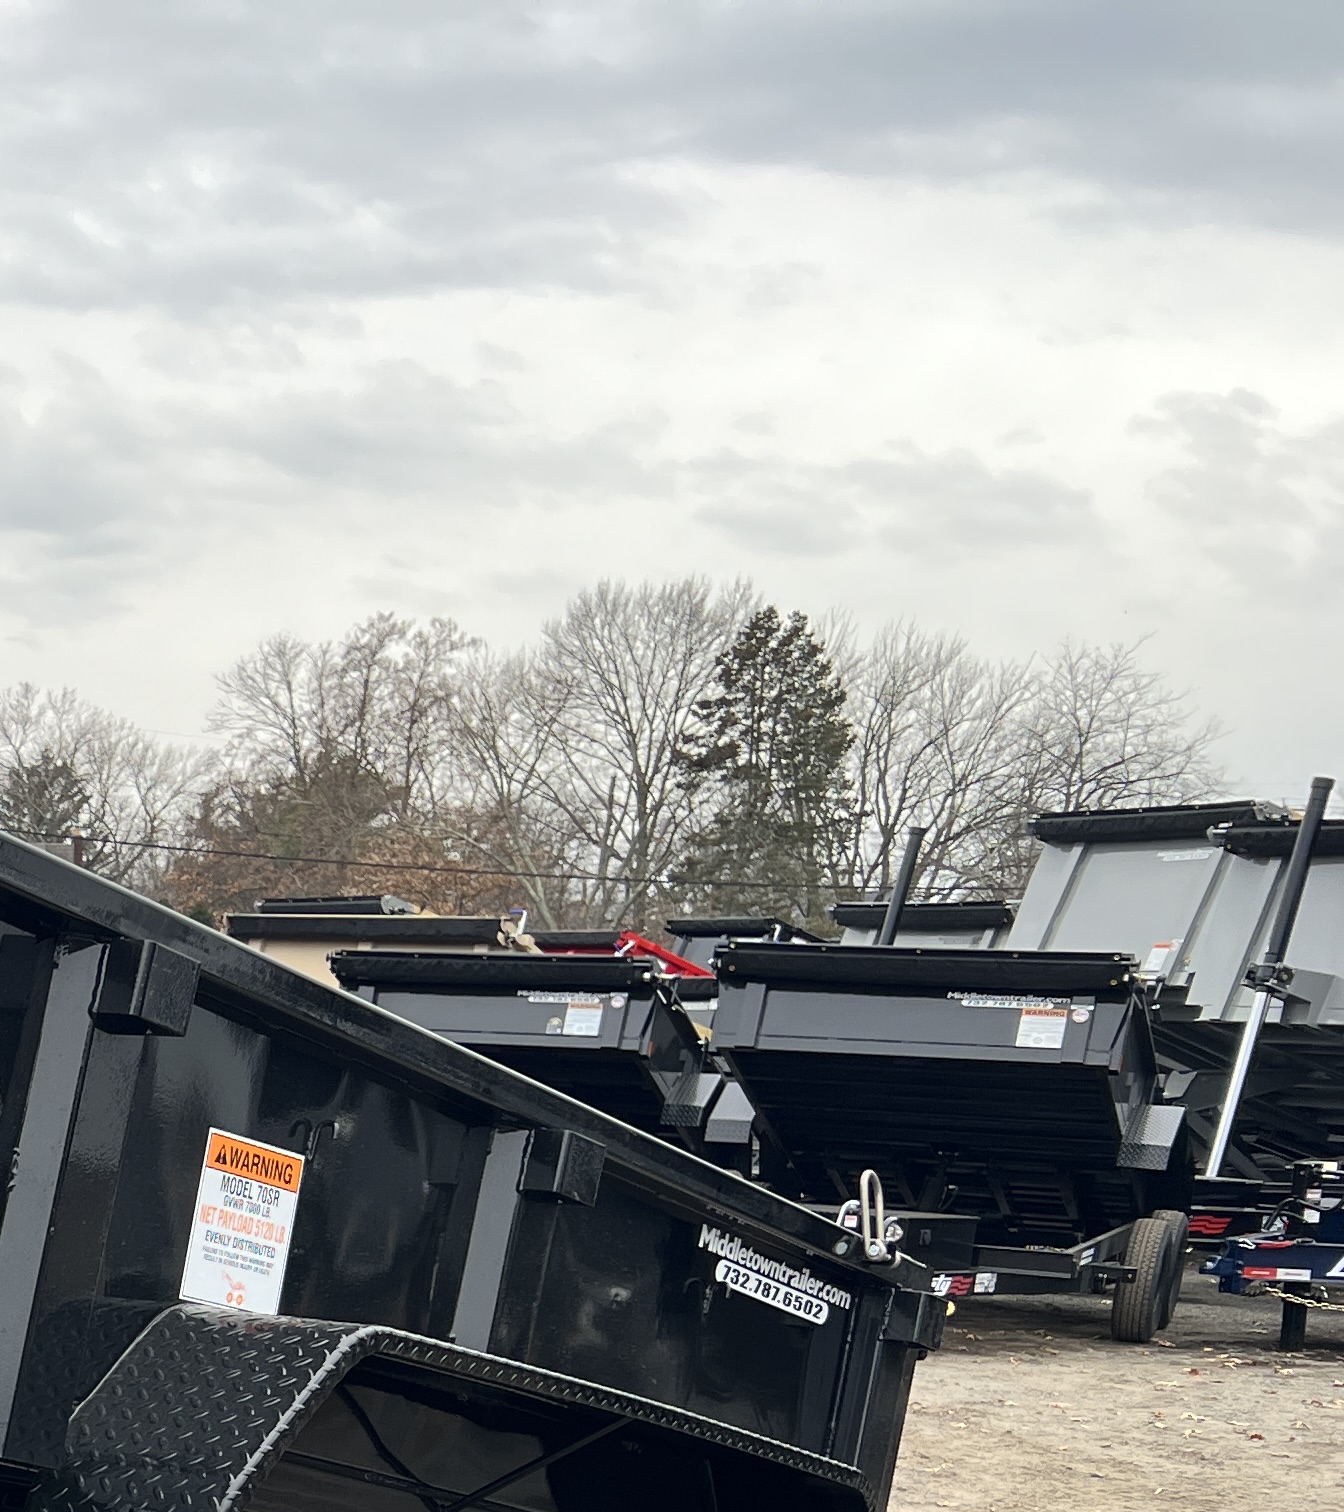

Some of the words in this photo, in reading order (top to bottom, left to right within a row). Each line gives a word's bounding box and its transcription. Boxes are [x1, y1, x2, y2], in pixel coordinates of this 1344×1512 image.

[229, 1145, 294, 1186] WARNING
[220, 1174, 252, 1200] MODEL
[257, 1185, 280, 1207] 70SR
[200, 1204, 217, 1226] NET
[218, 1209, 254, 1235] PAYLOAD
[255, 1219, 274, 1241] 5120
[205, 1230, 232, 1248] EVENLY
[232, 1236, 276, 1258] DISTRIBUTED
[698, 1223, 852, 1310] Middletowntrailer.com
[722, 1264, 824, 1320] 732.787.6502
